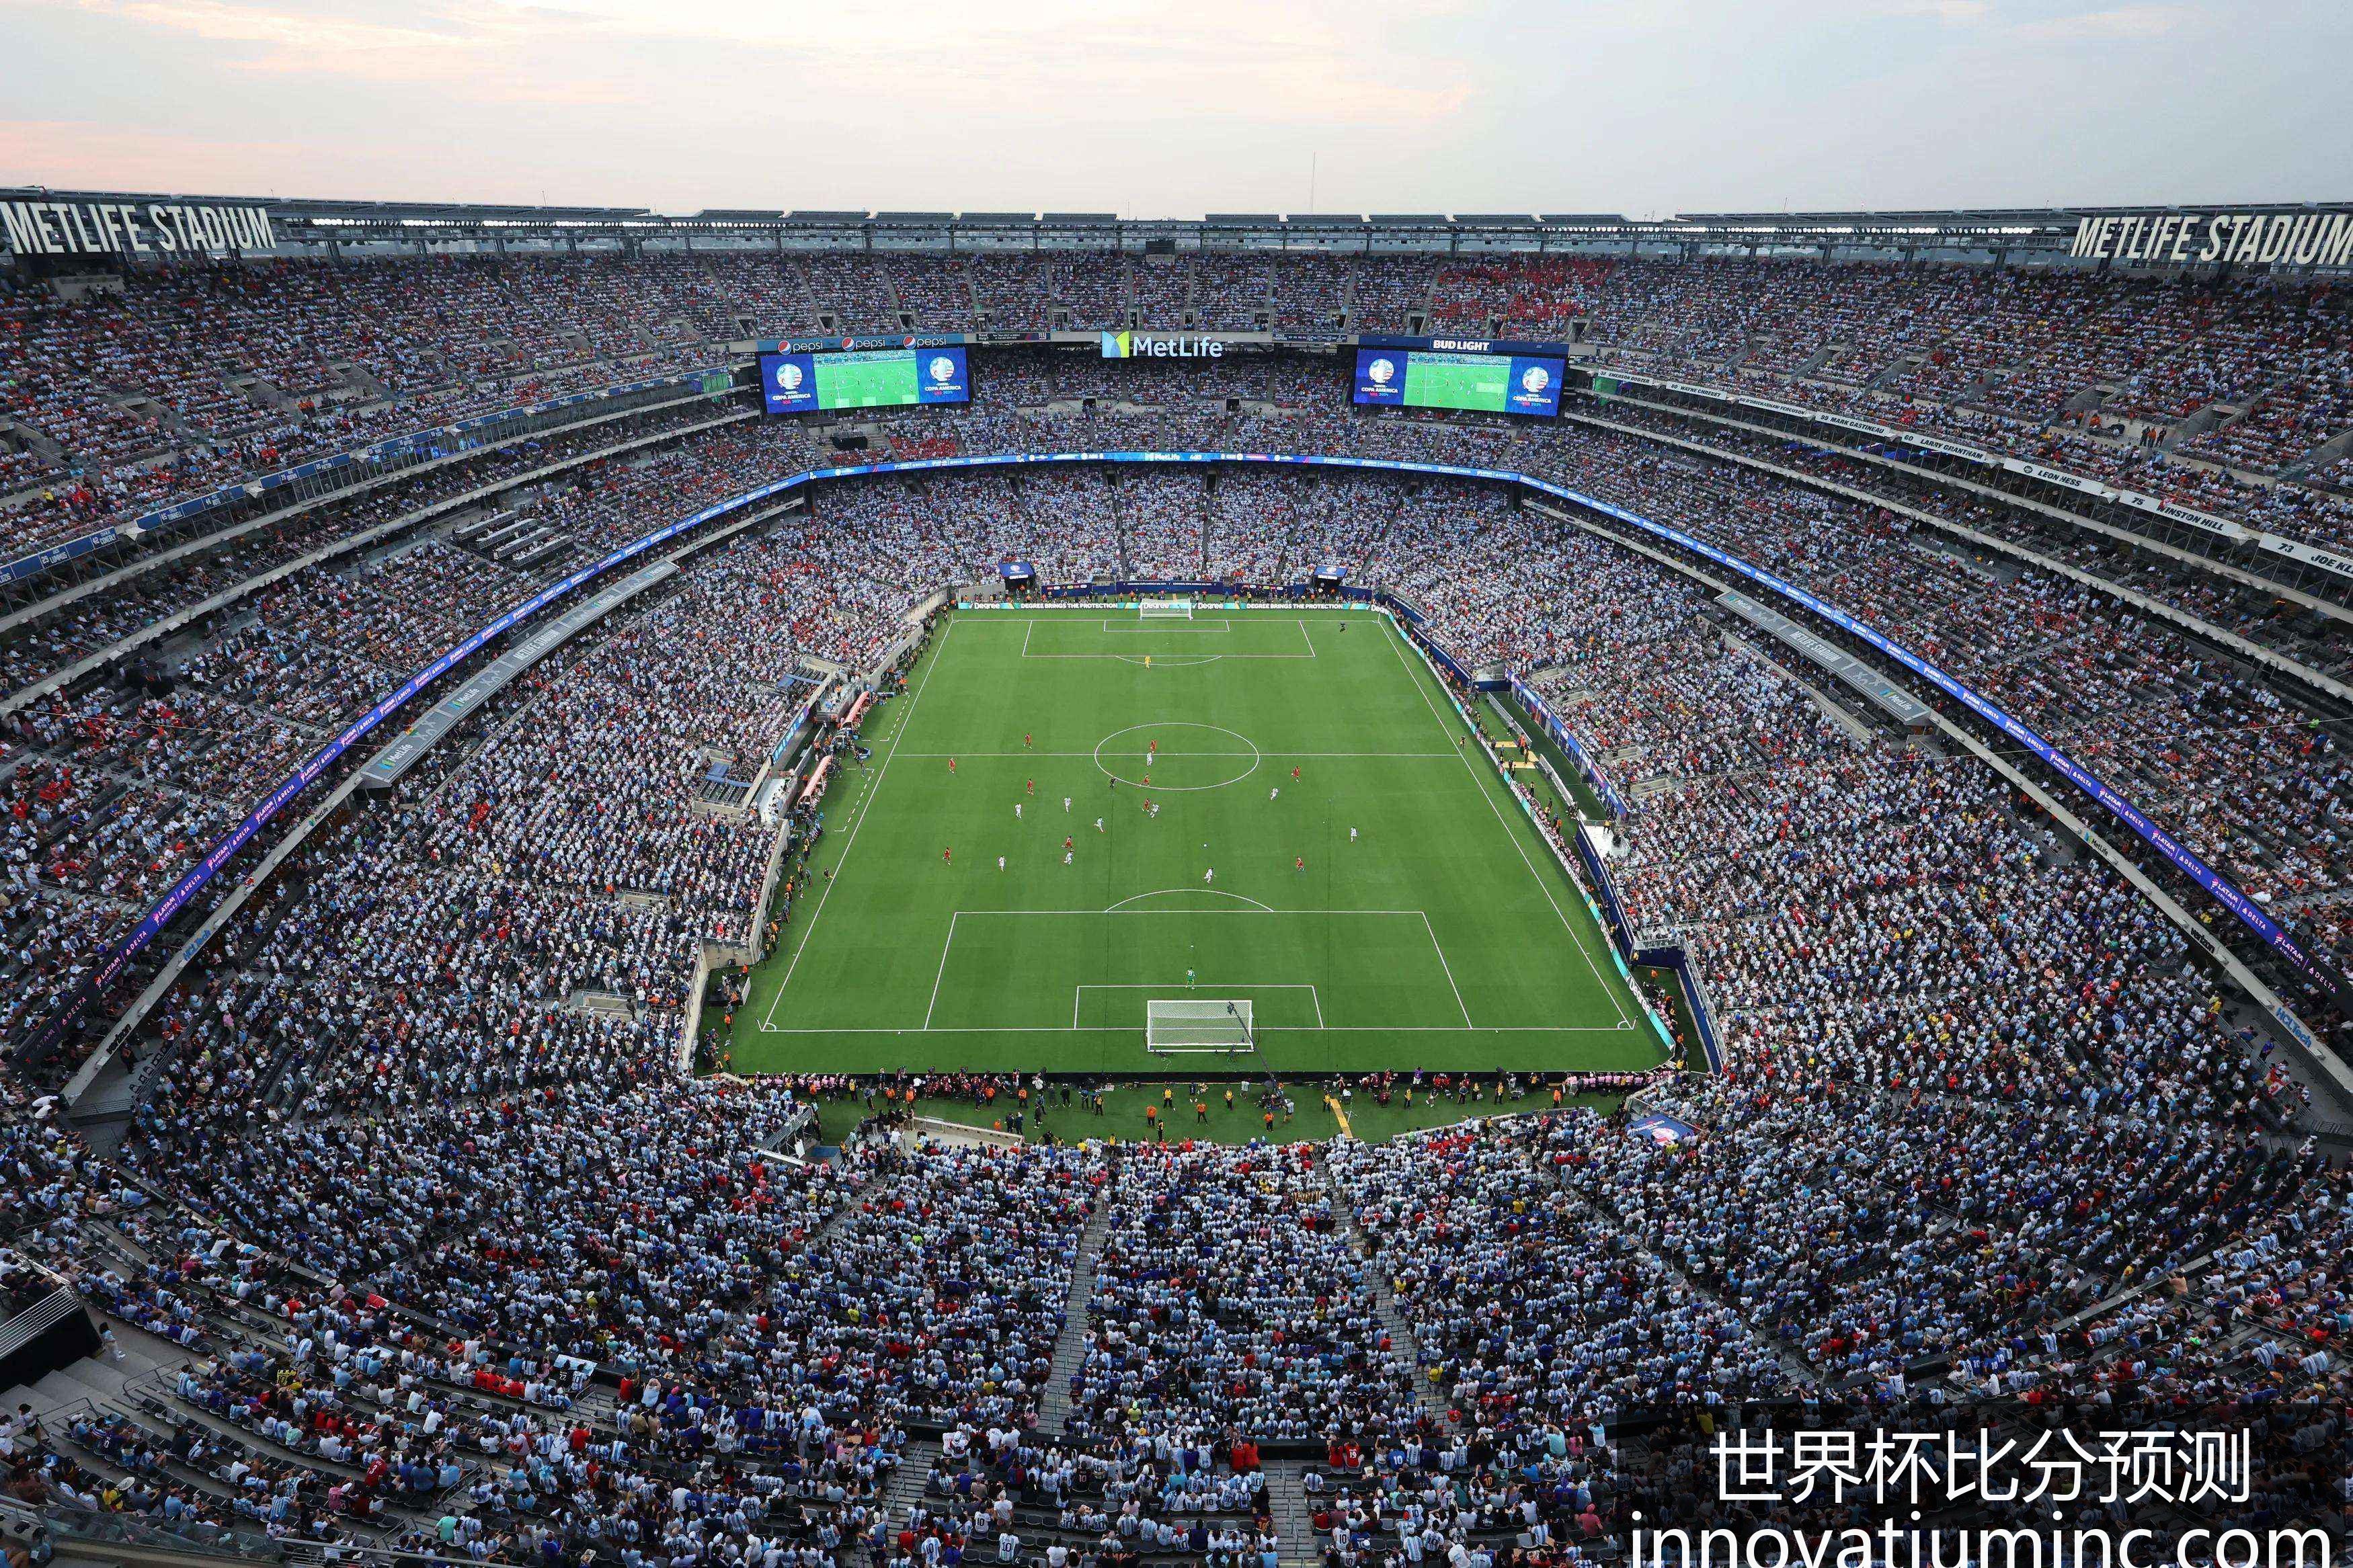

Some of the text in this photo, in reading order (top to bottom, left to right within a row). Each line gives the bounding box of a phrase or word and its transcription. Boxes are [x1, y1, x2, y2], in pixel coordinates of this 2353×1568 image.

[0, 202, 276, 254] METLIFE STADIUM
[2070, 214, 2353, 265] METLIFE STADIUM
[793, 341, 823, 354] pepsi
[855, 338, 885, 349] pepsi
[916, 336, 947, 347] pepsi
[1133, 336, 1223, 357] MetLife
[1433, 339, 1490, 351] BUD LIGHT
[1680, 385, 1697, 393] WAYNE
[1831, 417, 1849, 429] MARK
[1920, 439, 1943, 449] LARRY
[2037, 470, 2081, 487] LEON HESS
[2200, 518, 2225, 531] HILL
[2278, 542, 2295, 553] 73
[2311, 554, 2337, 567] JOE
[457, 687, 480, 704] MetLife
[1888, 694, 1912, 711] MetLife
[363, 716, 374, 727] DELTA
[2010, 723, 2025, 736] LATAM
[388, 743, 413, 762] MetLife
[2031, 739, 2044, 751] DELTA
[325, 747, 336, 760] DELTA
[305, 761, 318, 777] LATAM
[2054, 755, 2070, 769] LATAM
[2077, 774, 2091, 788] DELTA
[281, 784, 295, 798] DELTA
[260, 800, 274, 816] LATAM
[2103, 798, 2120, 813] AIRLINES
[2104, 792, 2122, 808] LATAM
[2129, 814, 2144, 828] DELTA
[237, 826, 250, 841] DELTA
[2091, 839, 2108, 856] MetLife
[2155, 841, 2173, 857] AIRLINES
[2157, 835, 2176, 851] LATAM
[212, 845, 229, 862] LATAM
[2184, 860, 2201, 876] DELTA
[185, 874, 201, 893] DELTA
[2219, 883, 2238, 903] LATAM
[159, 897, 175, 916] LATAM
[2248, 911, 2266, 931] DELTA
[130, 931, 147, 951] DELTA
[2191, 927, 2215, 953] verizon
[2282, 940, 2304, 962] LATAM
[101, 956, 120, 980] LATAM
[2315, 972, 2336, 994] DELTA
[1628, 979, 1650, 1016] Degree
[67, 996, 87, 1020] DELTA
[2276, 1007, 2312, 1048] HCLTech
[106, 1023, 132, 1055] verizon
